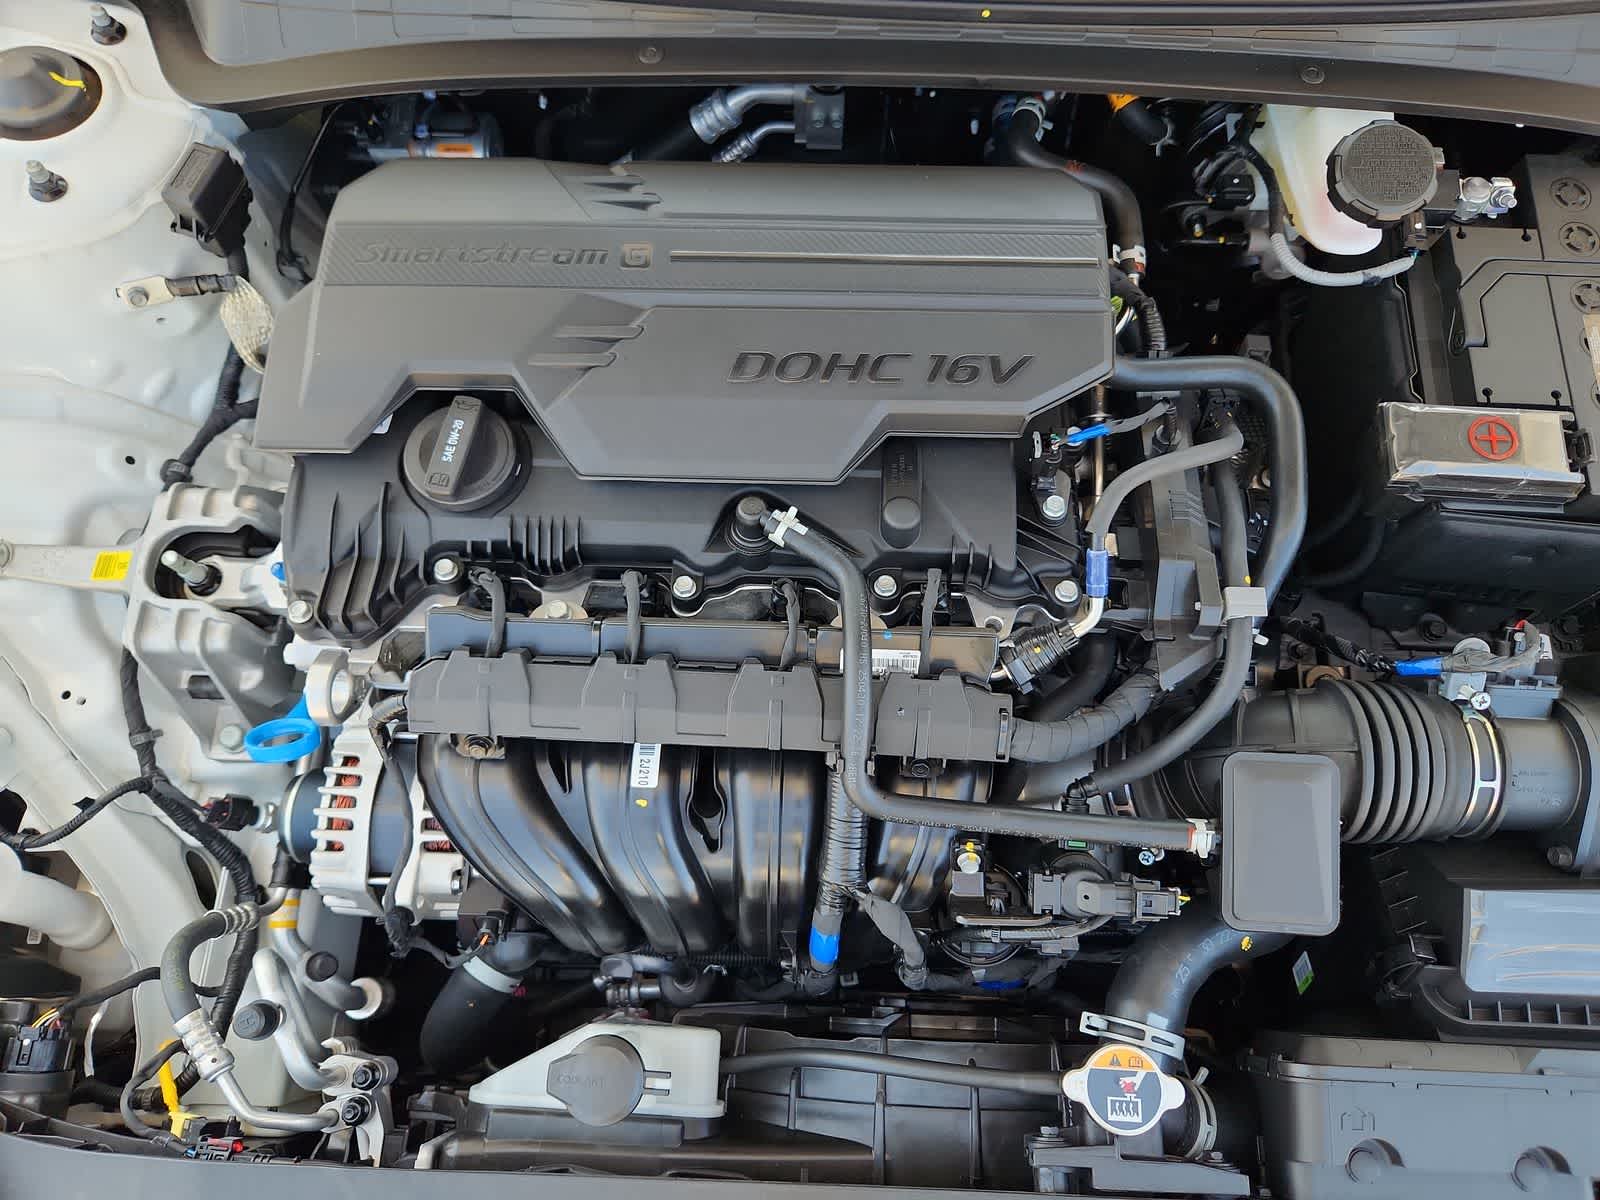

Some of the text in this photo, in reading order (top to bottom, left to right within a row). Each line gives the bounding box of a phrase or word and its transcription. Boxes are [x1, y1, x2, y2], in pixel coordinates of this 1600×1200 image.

[353, 241, 650, 268] Smartstream G
[727, 350, 1035, 385] DOHC 16V
[442, 443, 456, 462] SAE
[637, 758, 651, 786] 2J210
